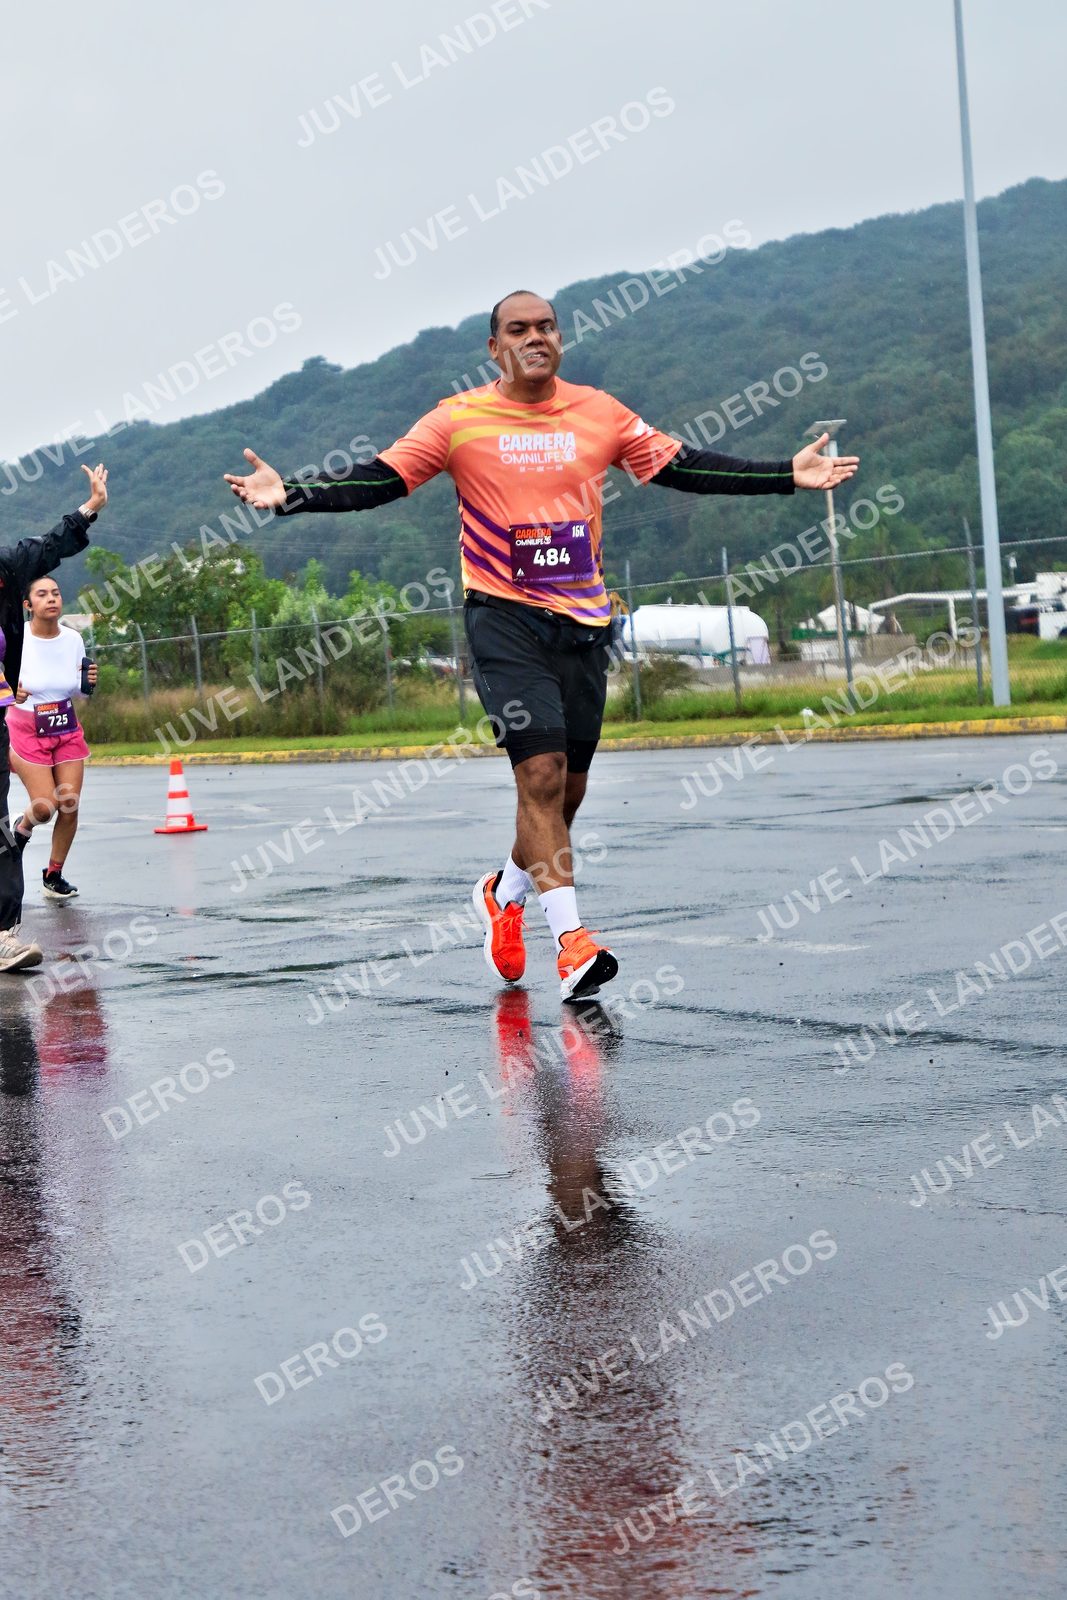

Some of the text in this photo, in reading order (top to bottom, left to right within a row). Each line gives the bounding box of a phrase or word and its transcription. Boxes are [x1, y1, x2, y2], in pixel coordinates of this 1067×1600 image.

[498, 432, 576, 451] CARRERA
[501, 452, 560, 464] OMNILIFE
[515, 527, 552, 539] CARRERA
[533, 548, 570, 566] 484
[48, 714, 68, 727] 725
